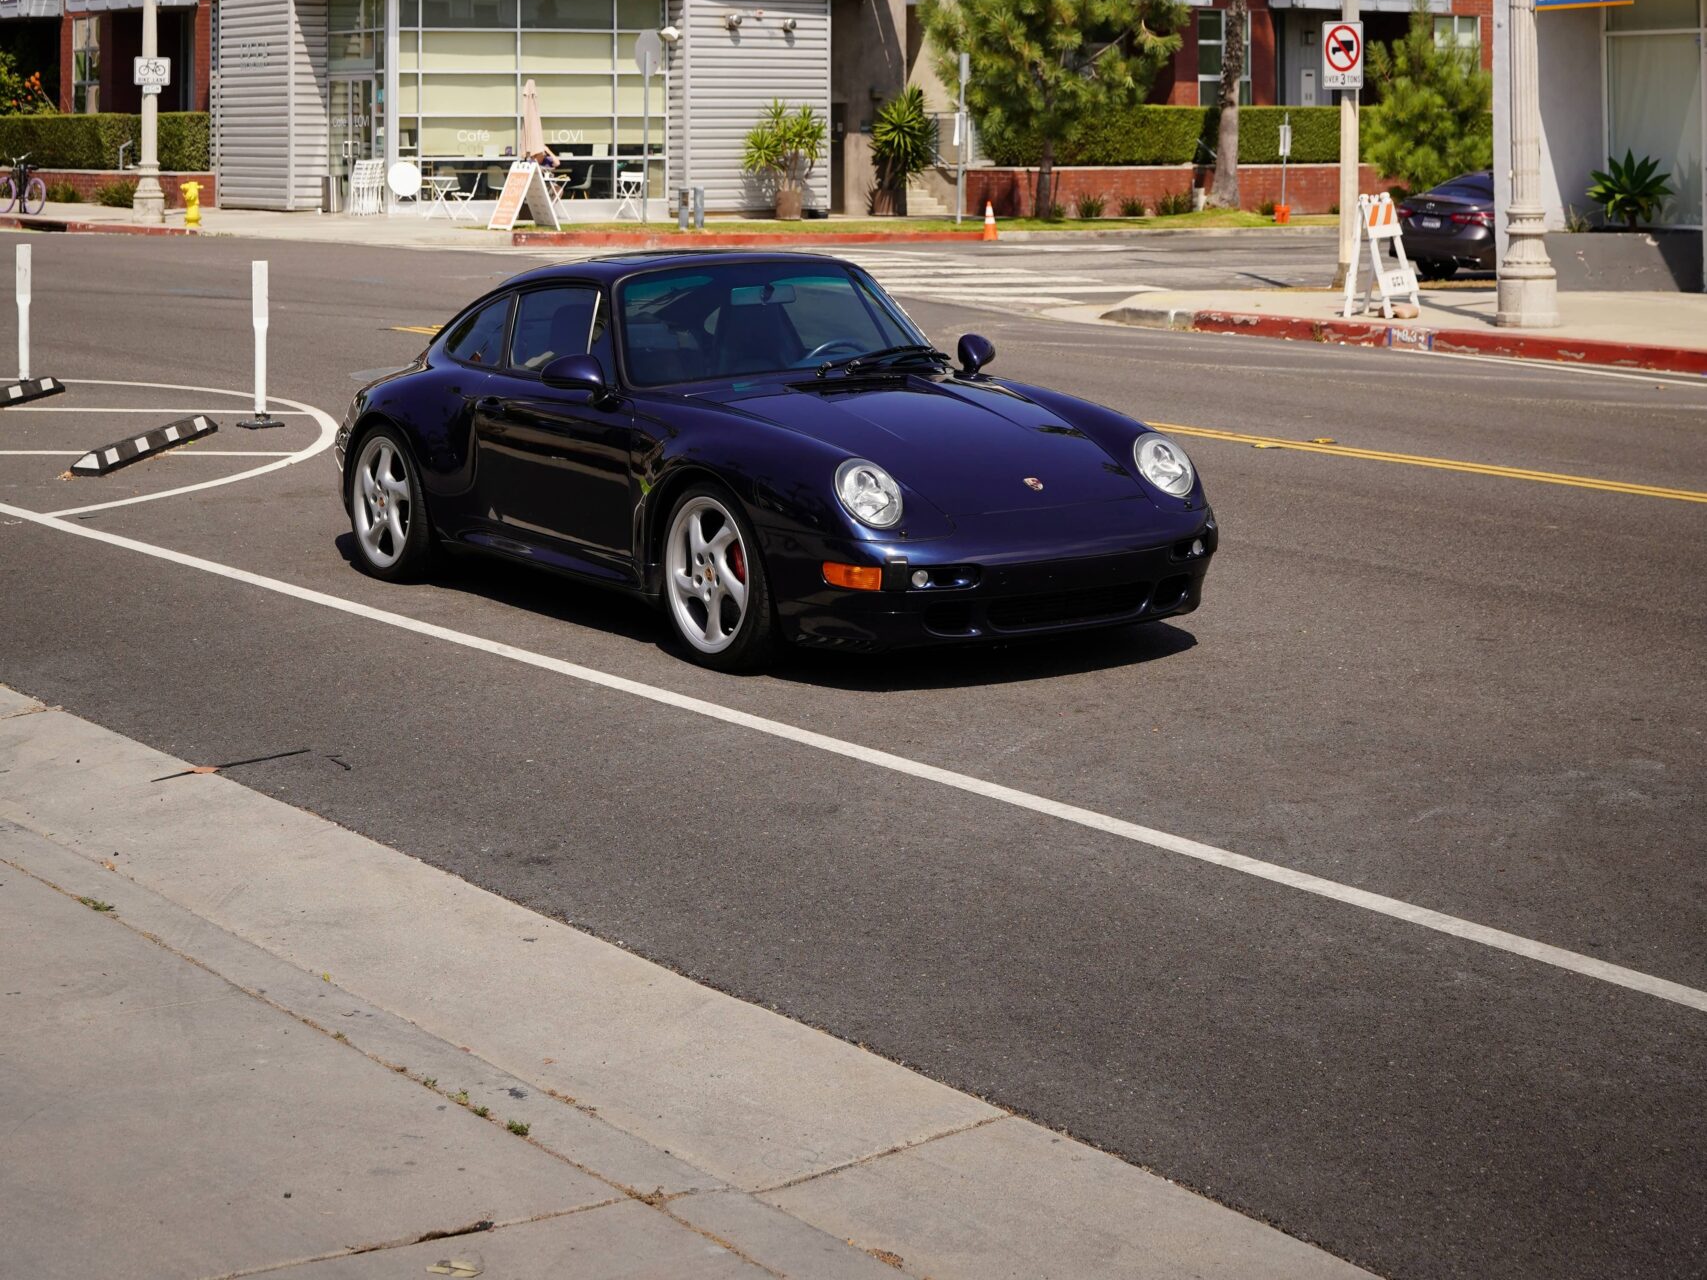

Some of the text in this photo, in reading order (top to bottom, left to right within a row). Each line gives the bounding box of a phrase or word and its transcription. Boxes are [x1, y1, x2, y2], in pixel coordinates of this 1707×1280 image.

[1324, 73, 1361, 85] OVER 3 TONS
[457, 129, 583, 143] Café LOVI
